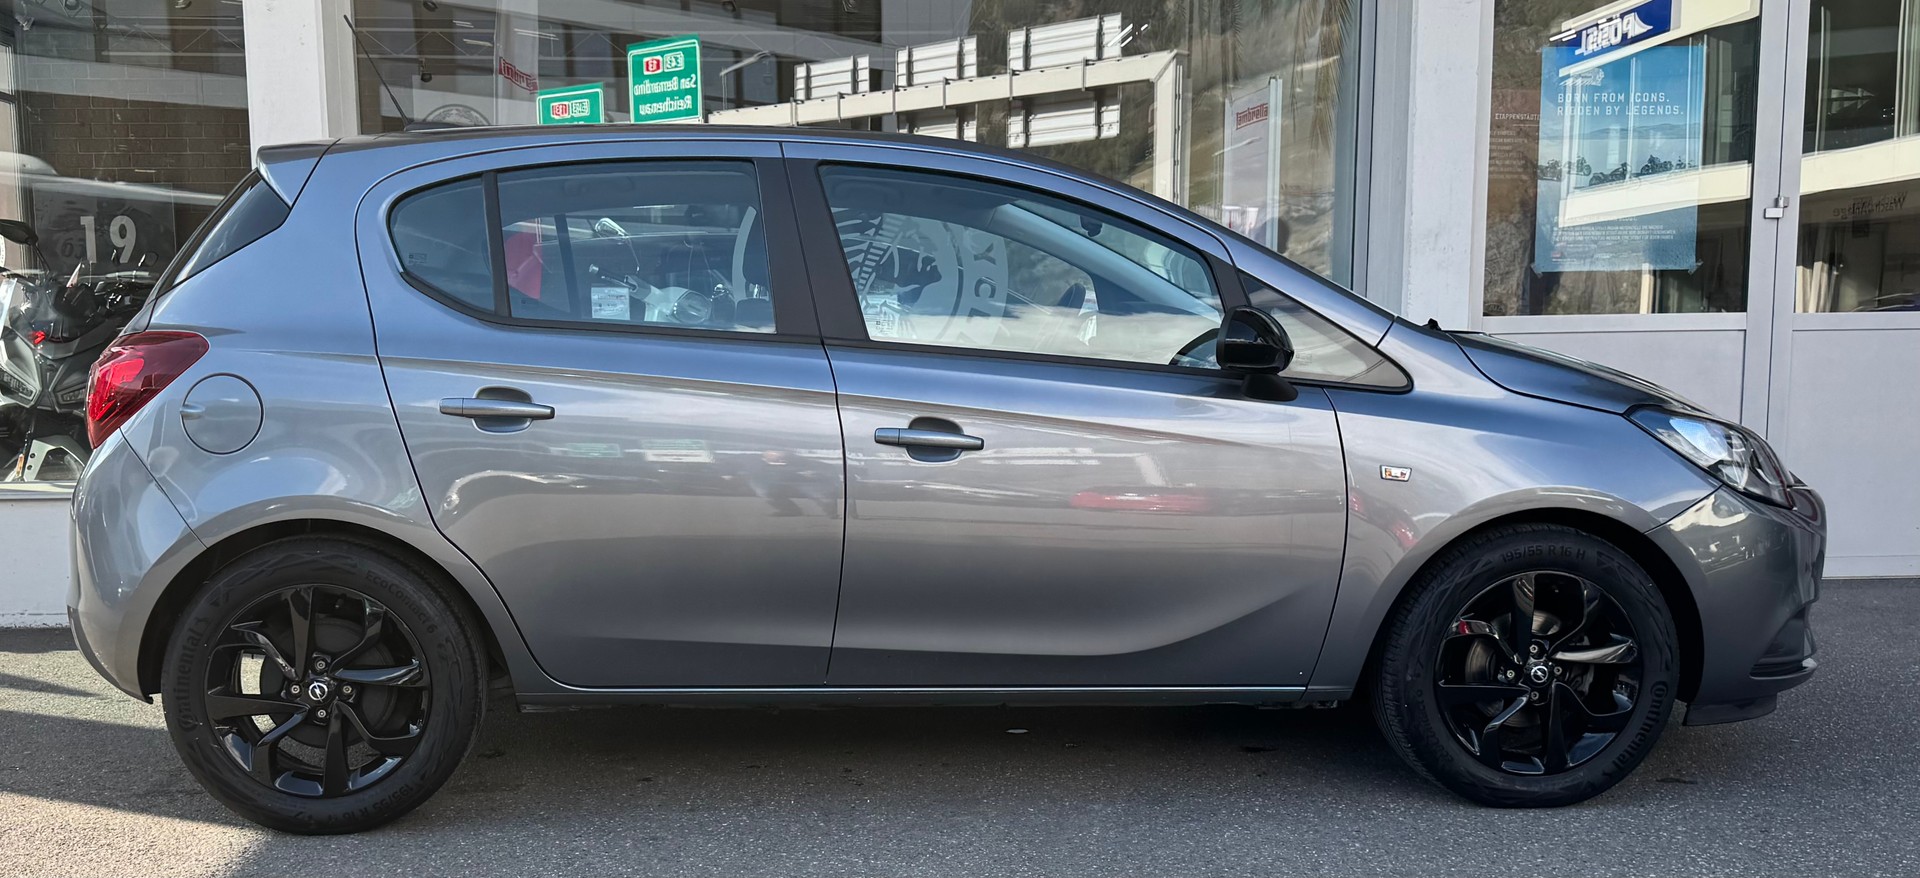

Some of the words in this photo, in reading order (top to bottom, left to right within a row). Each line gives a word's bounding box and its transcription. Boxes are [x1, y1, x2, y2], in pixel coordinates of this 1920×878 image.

[1557, 92, 1588, 104] BORN
[1593, 92, 1625, 103] FROM
[1629, 91, 1670, 103] ICONS.
[1556, 104, 1600, 117] RIDDEN
[1605, 104, 1620, 116] BY
[1625, 104, 1684, 116] LEGENDS.
[1501, 545, 1543, 562] 195/55
[1548, 544, 1557, 556] R
[1560, 545, 1572, 557] 16
[1575, 548, 1587, 560] H
[175, 626, 205, 733] Continental
[1611, 680, 1669, 769] Continental
